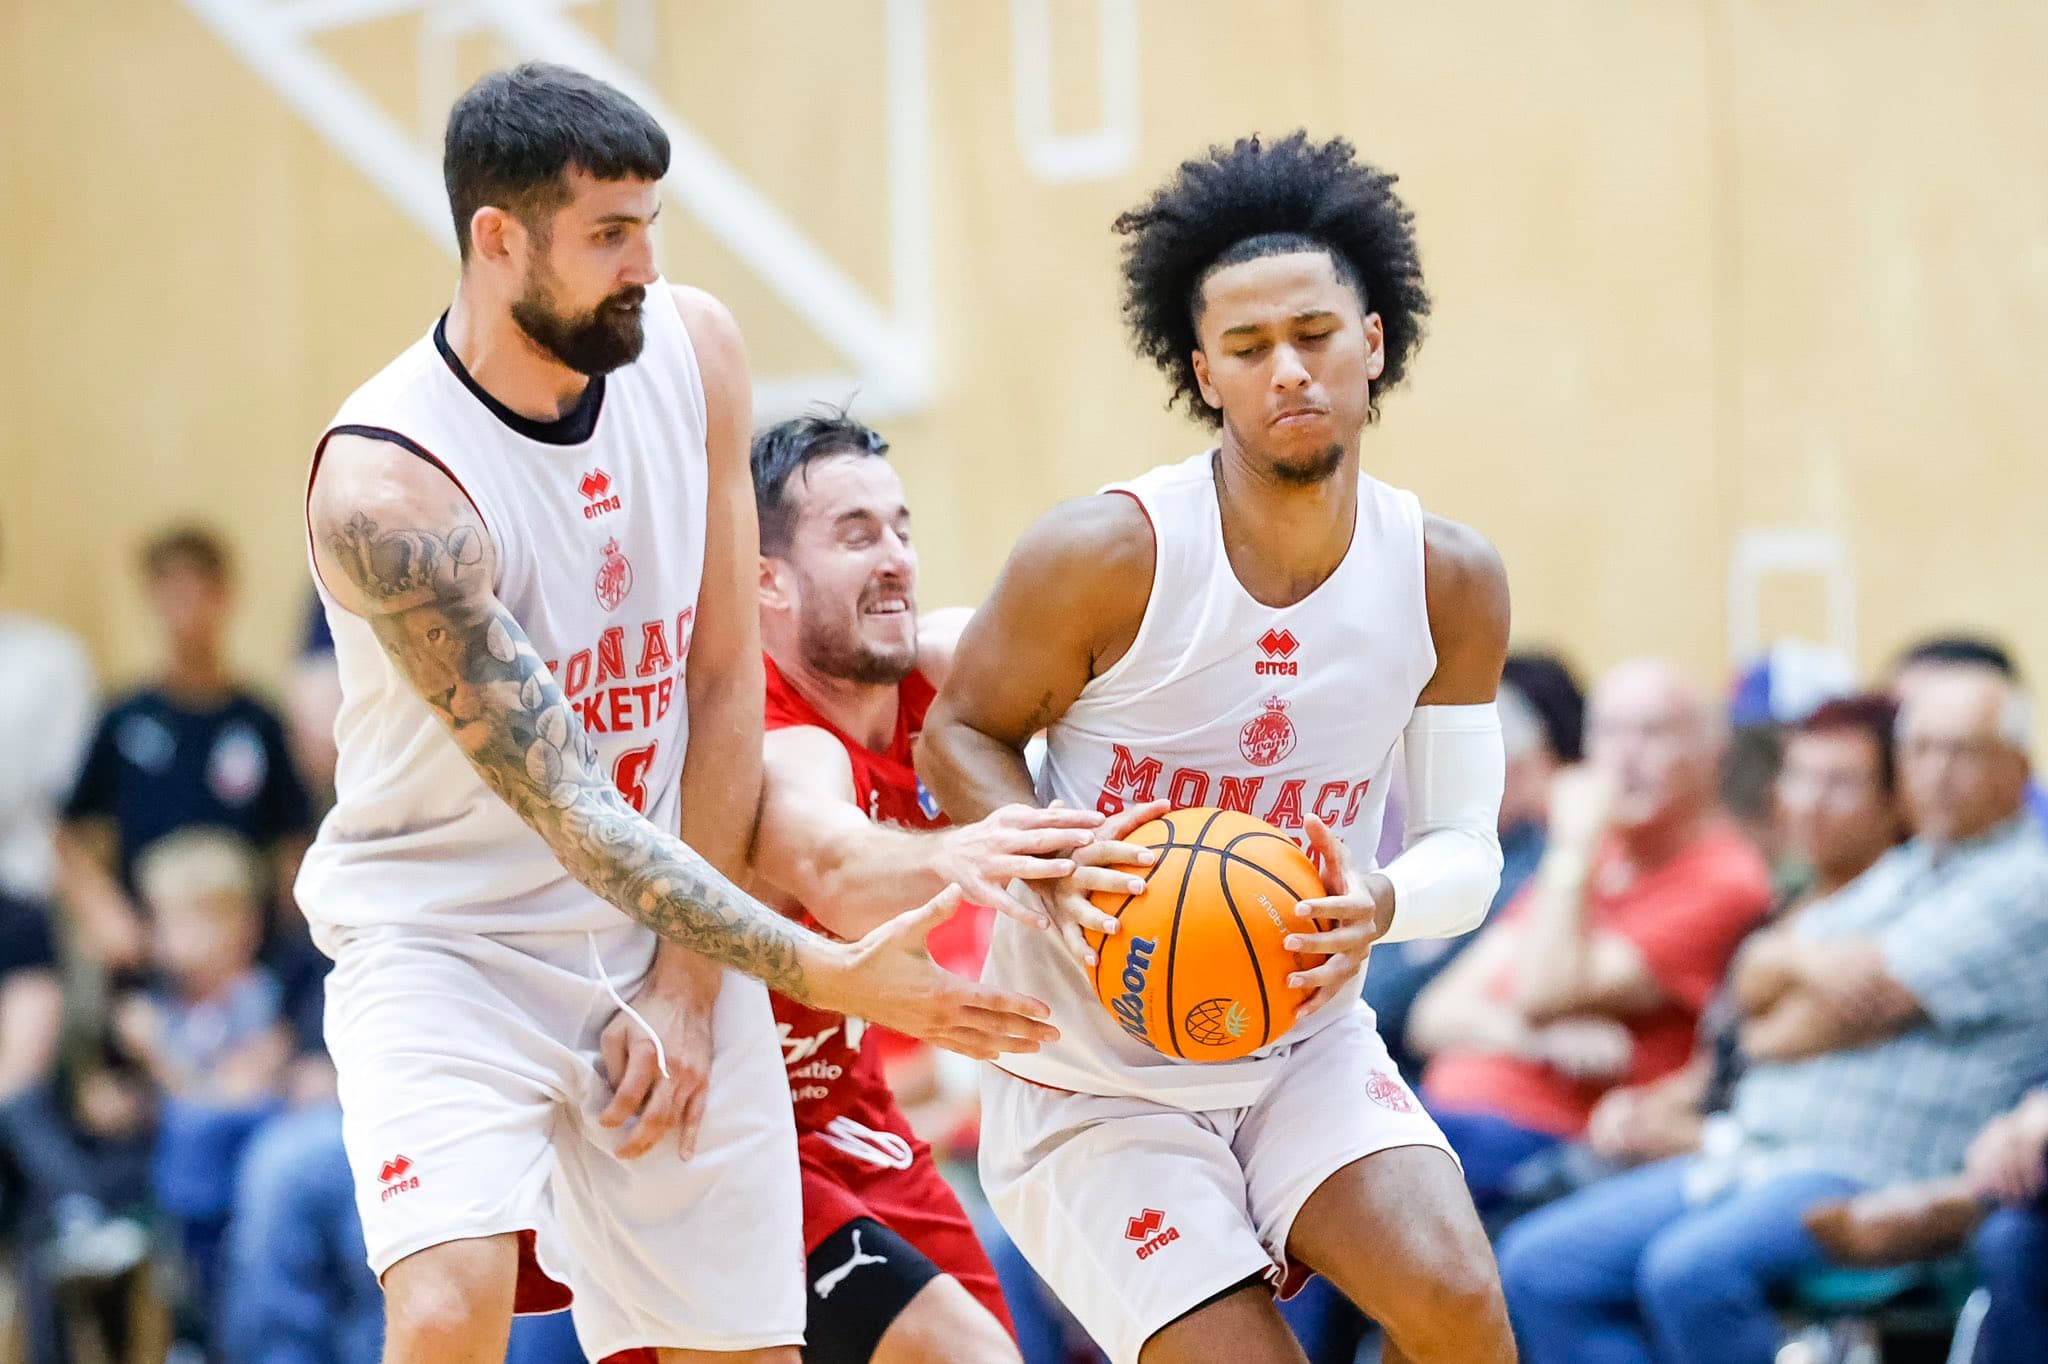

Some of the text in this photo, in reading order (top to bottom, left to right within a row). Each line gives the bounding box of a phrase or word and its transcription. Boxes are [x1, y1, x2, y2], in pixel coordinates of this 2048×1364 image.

[583, 494, 621, 520] errea
[1255, 661, 1298, 676] errea
[381, 1176, 420, 1202] errea
[1135, 1226, 1181, 1261] errea
